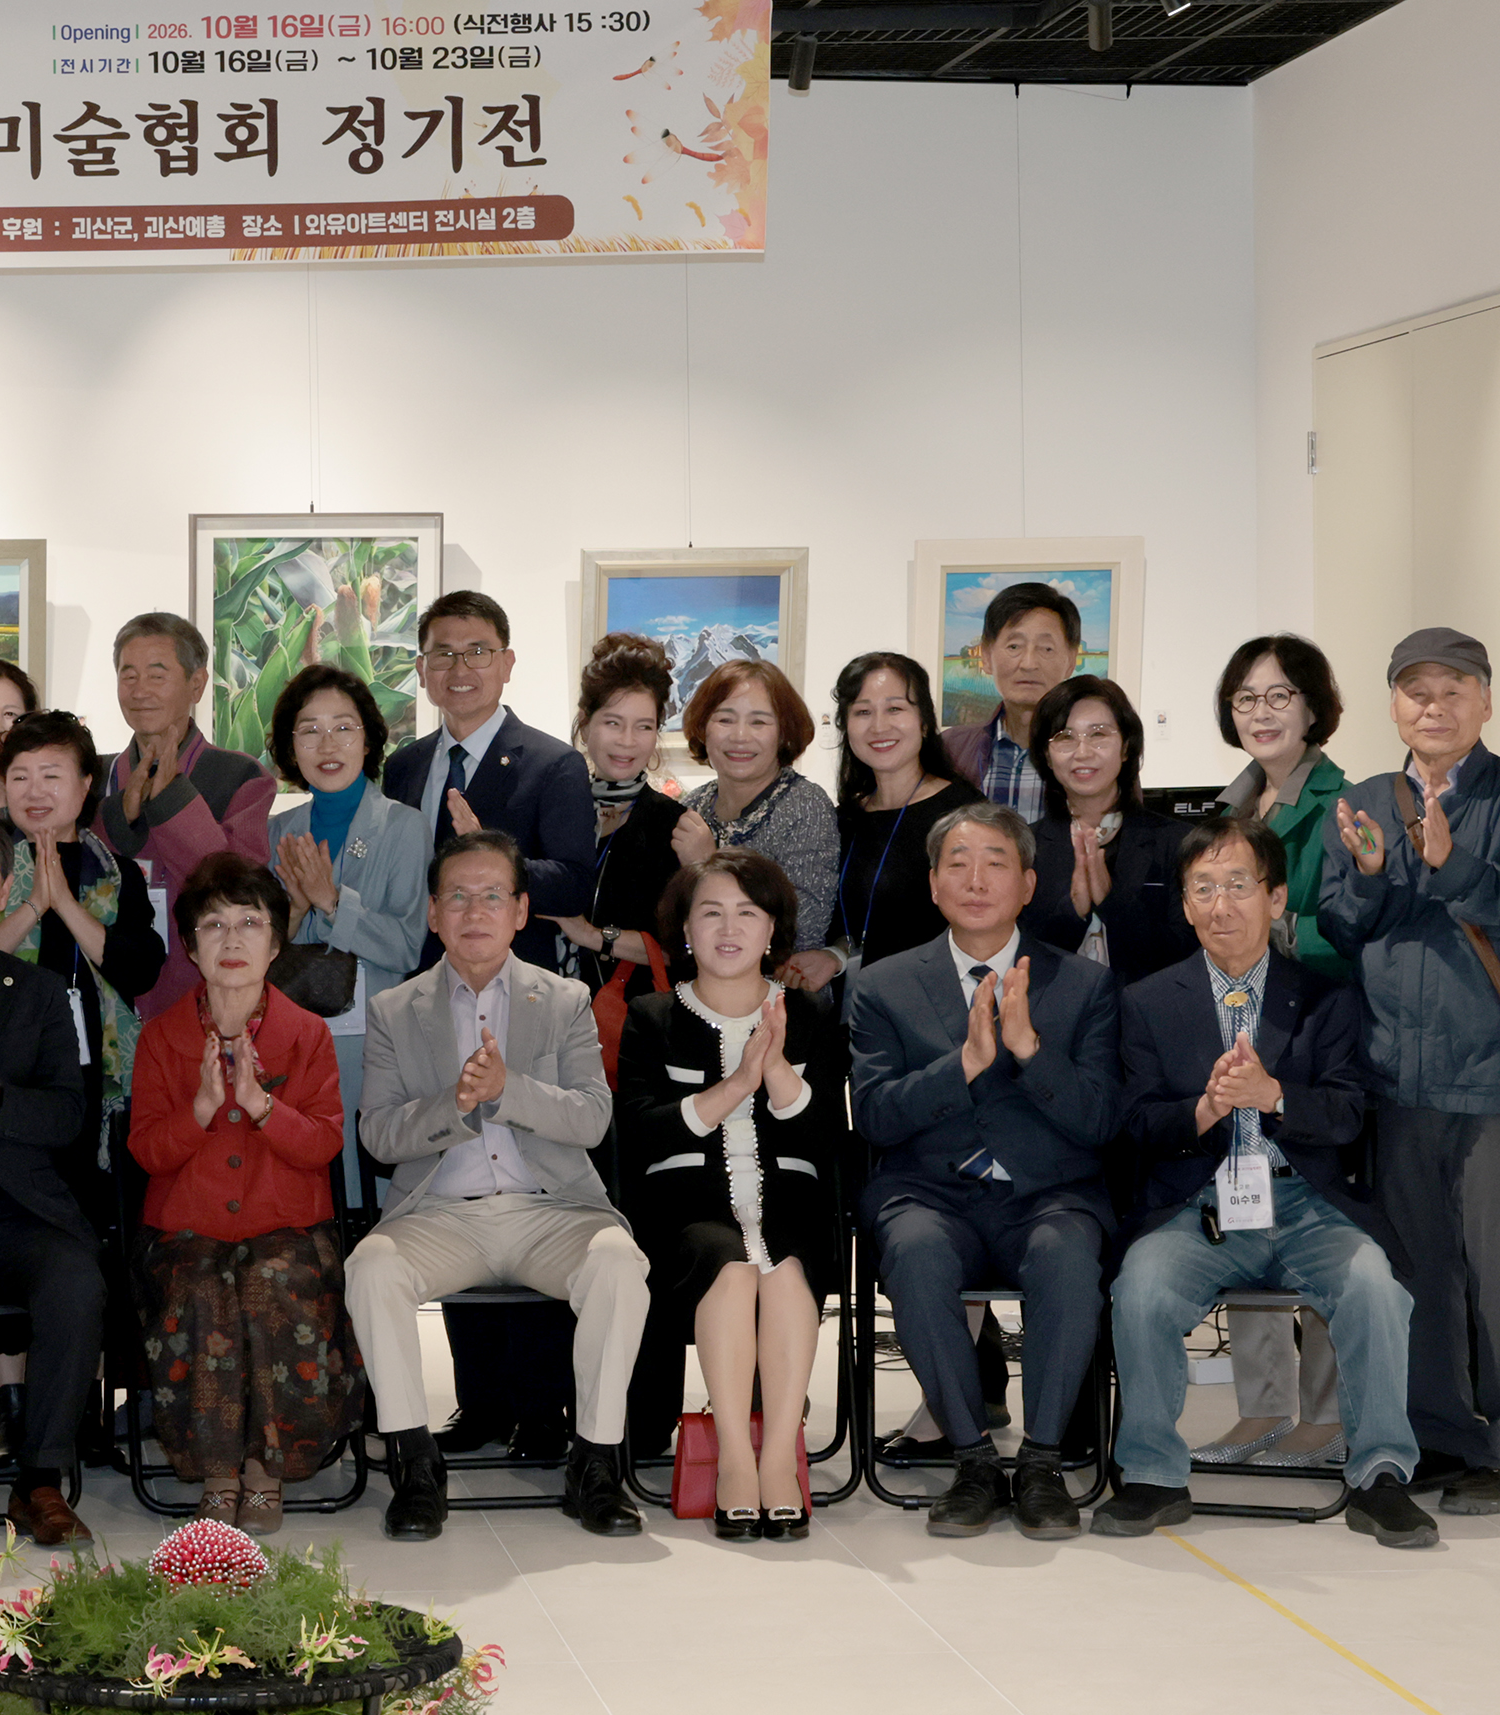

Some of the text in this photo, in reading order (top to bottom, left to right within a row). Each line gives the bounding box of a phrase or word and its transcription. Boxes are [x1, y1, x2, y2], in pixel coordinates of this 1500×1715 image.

[60, 24, 131, 43] Opening
[147, 23, 193, 39] 2026.
[200, 14, 258, 39] 10월
[266, 14, 372, 39] 16일(금)
[380, 16, 445, 36] 16:00
[453, 13, 557, 35] (식전행사
[148, 50, 206, 74] 10월
[214, 49, 319, 73] 16일(금)
[366, 47, 423, 70] 10월
[432, 45, 542, 70] 23일(금)
[321, 94, 548, 175] 정기전
[2, 218, 43, 240] 후원
[71, 217, 139, 241] 괴산군,
[144, 215, 226, 239] 괴산예총
[242, 215, 283, 237] 장소
[305, 211, 428, 236] 와유아트센터
[434, 208, 497, 232] 전시실
[502, 206, 536, 230] 2층
[1174, 802, 1216, 814] ELF
